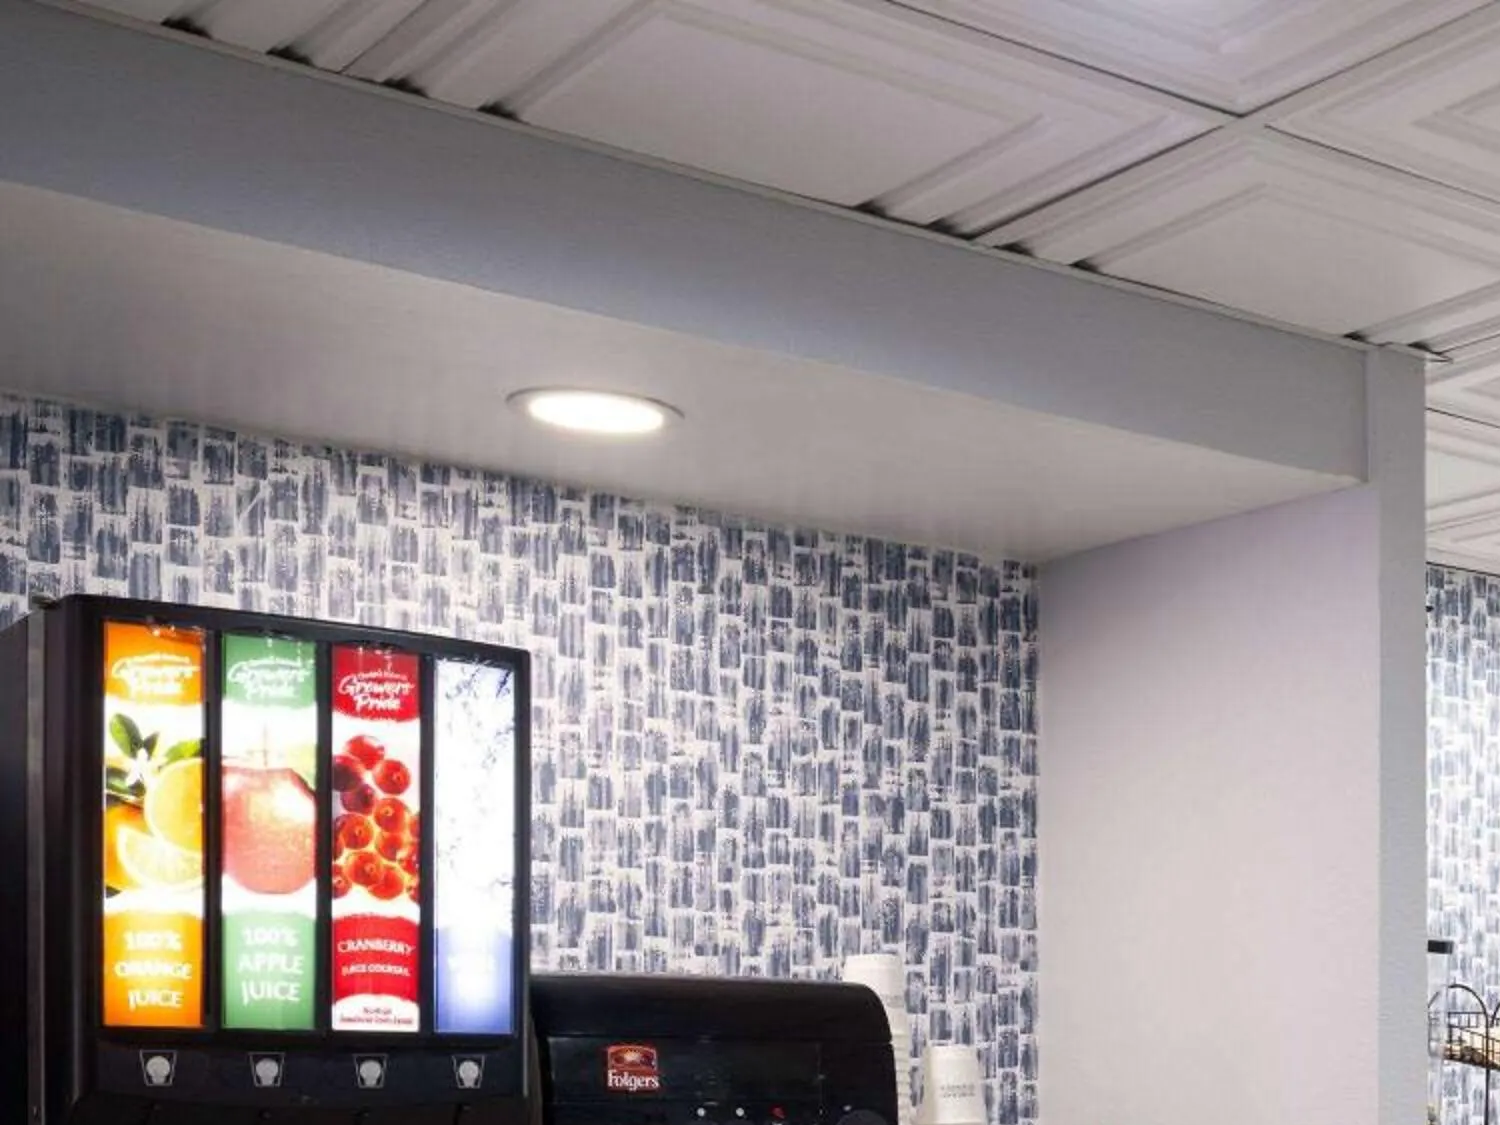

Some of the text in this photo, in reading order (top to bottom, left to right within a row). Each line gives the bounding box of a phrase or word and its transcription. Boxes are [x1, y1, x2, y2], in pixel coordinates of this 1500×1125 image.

[243, 927, 300, 947] 100%
[338, 938, 416, 956] CRANBERRY
[114, 960, 193, 980] ORANGE
[238, 953, 304, 975] APPLE
[128, 989, 185, 1012] JUICE
[241, 981, 301, 1007] JUICE
[607, 1069, 660, 1091] Folgers
